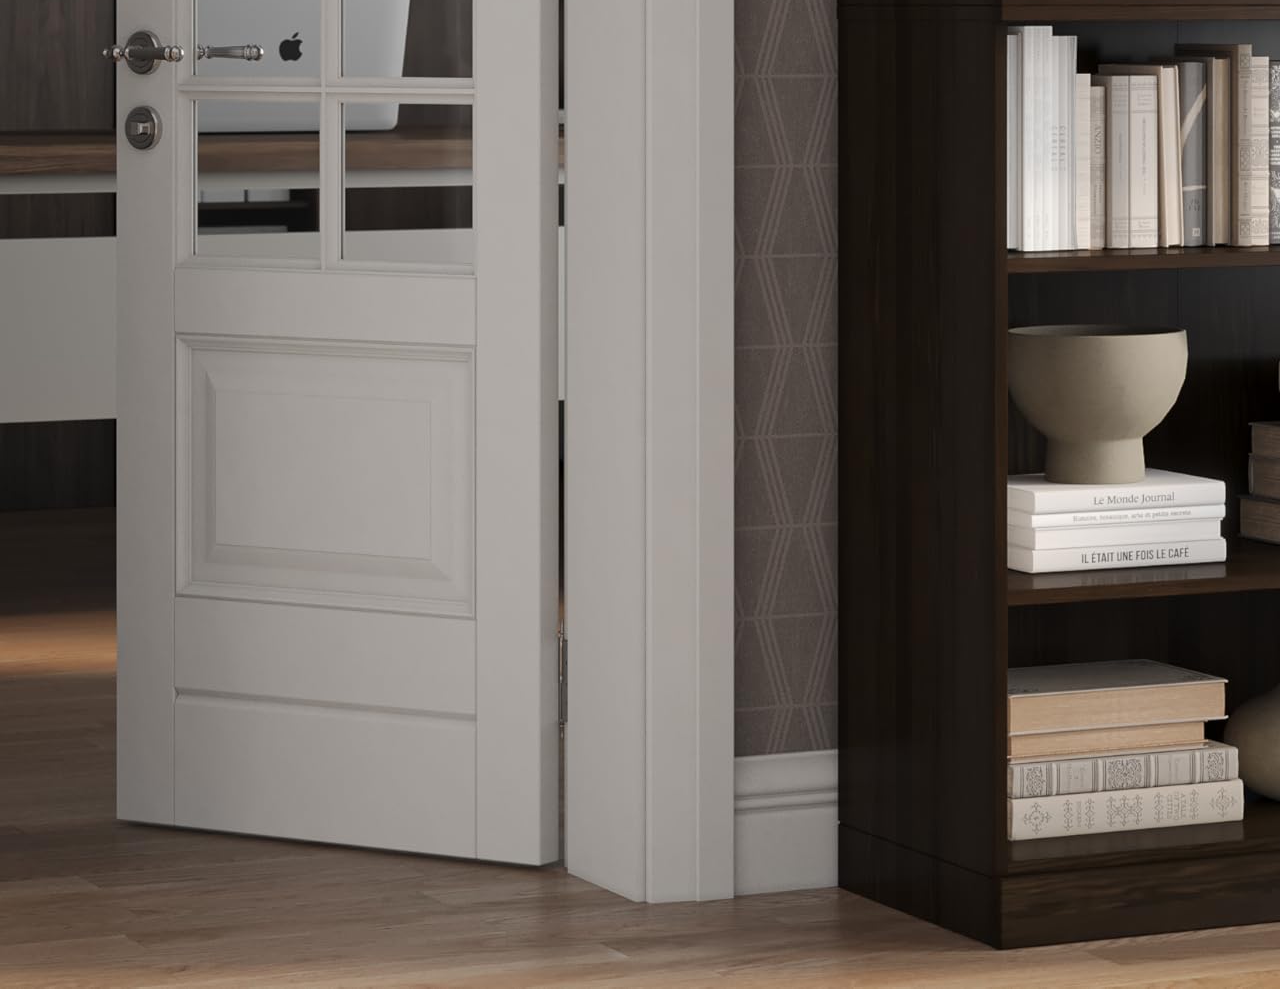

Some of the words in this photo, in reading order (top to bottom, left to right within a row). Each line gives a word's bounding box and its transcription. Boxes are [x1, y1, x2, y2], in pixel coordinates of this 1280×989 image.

[1093, 496, 1104, 506] Le
[1107, 493, 1139, 504] Monde
[1141, 491, 1175, 504] Journal
[1081, 553, 1089, 564] IL
[1091, 551, 1114, 563] ÉTAIT
[1116, 551, 1133, 562] UNE
[1135, 549, 1154, 560] FOIS
[1156, 549, 1166, 559] LE
